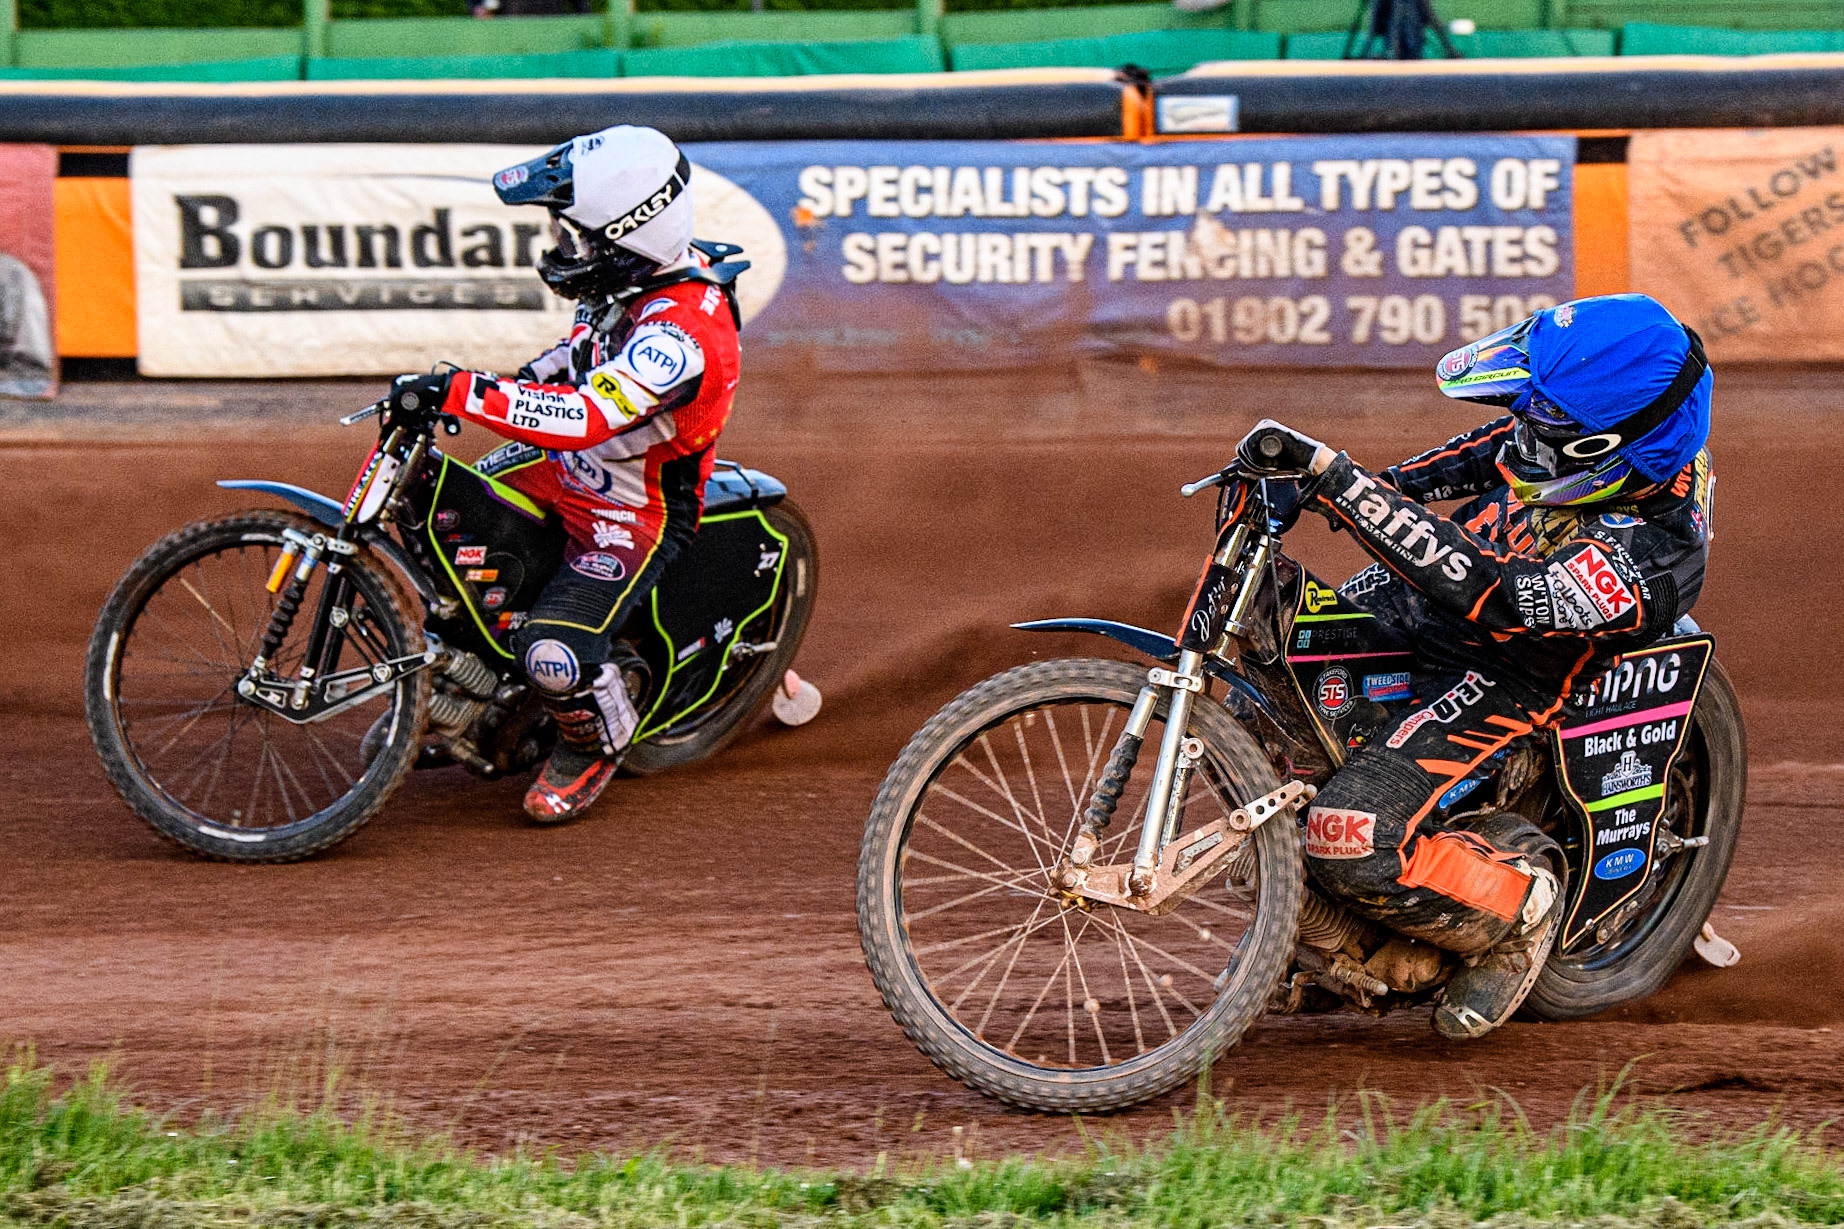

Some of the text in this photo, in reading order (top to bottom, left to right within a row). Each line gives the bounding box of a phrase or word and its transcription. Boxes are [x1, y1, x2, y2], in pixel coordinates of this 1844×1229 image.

[798, 157, 1561, 218] SPECIALISTS IN ALL TYPES OF
[1678, 146, 1837, 248] FOLLOW
[604, 183, 673, 241] OAKLEY
[172, 193, 541, 271] Boundar
[842, 231, 1094, 285] SECURITY
[1341, 226, 1384, 278] &
[1398, 224, 1560, 278] GATES
[1165, 296, 1331, 346] 01902
[1344, 295, 1447, 346] 790
[1458, 294, 1558, 344] 50
[637, 345, 679, 376] ATPI
[512, 413, 540, 429] LTD
[514, 399, 585, 421] PLASTICS
[1341, 467, 1474, 582] Taffys
[1566, 561, 1592, 600] SPARK
[1590, 590, 1614, 621] PLUGS
[1574, 547, 1632, 615] NGK
[1516, 576, 1536, 629] SKIPS
[1550, 569, 1593, 627] talbots
[1311, 627, 1358, 640] PRESTIGE
[532, 660, 570, 678] ATPI
[1319, 668, 1349, 683] STAKEFORD
[1366, 672, 1411, 688] TWEEDSIDE
[1319, 683, 1346, 701] STS
[1390, 709, 1436, 746] Campers
[1583, 719, 1678, 758] Black & Gold
[1601, 772, 1653, 797] HAINSWORTHS
[1306, 812, 1370, 845] NGK
[1595, 821, 1651, 847] Murrays
[1614, 807, 1637, 828] The
[1307, 843, 1332, 856] SPARK
[1605, 852, 1636, 870] KMW
